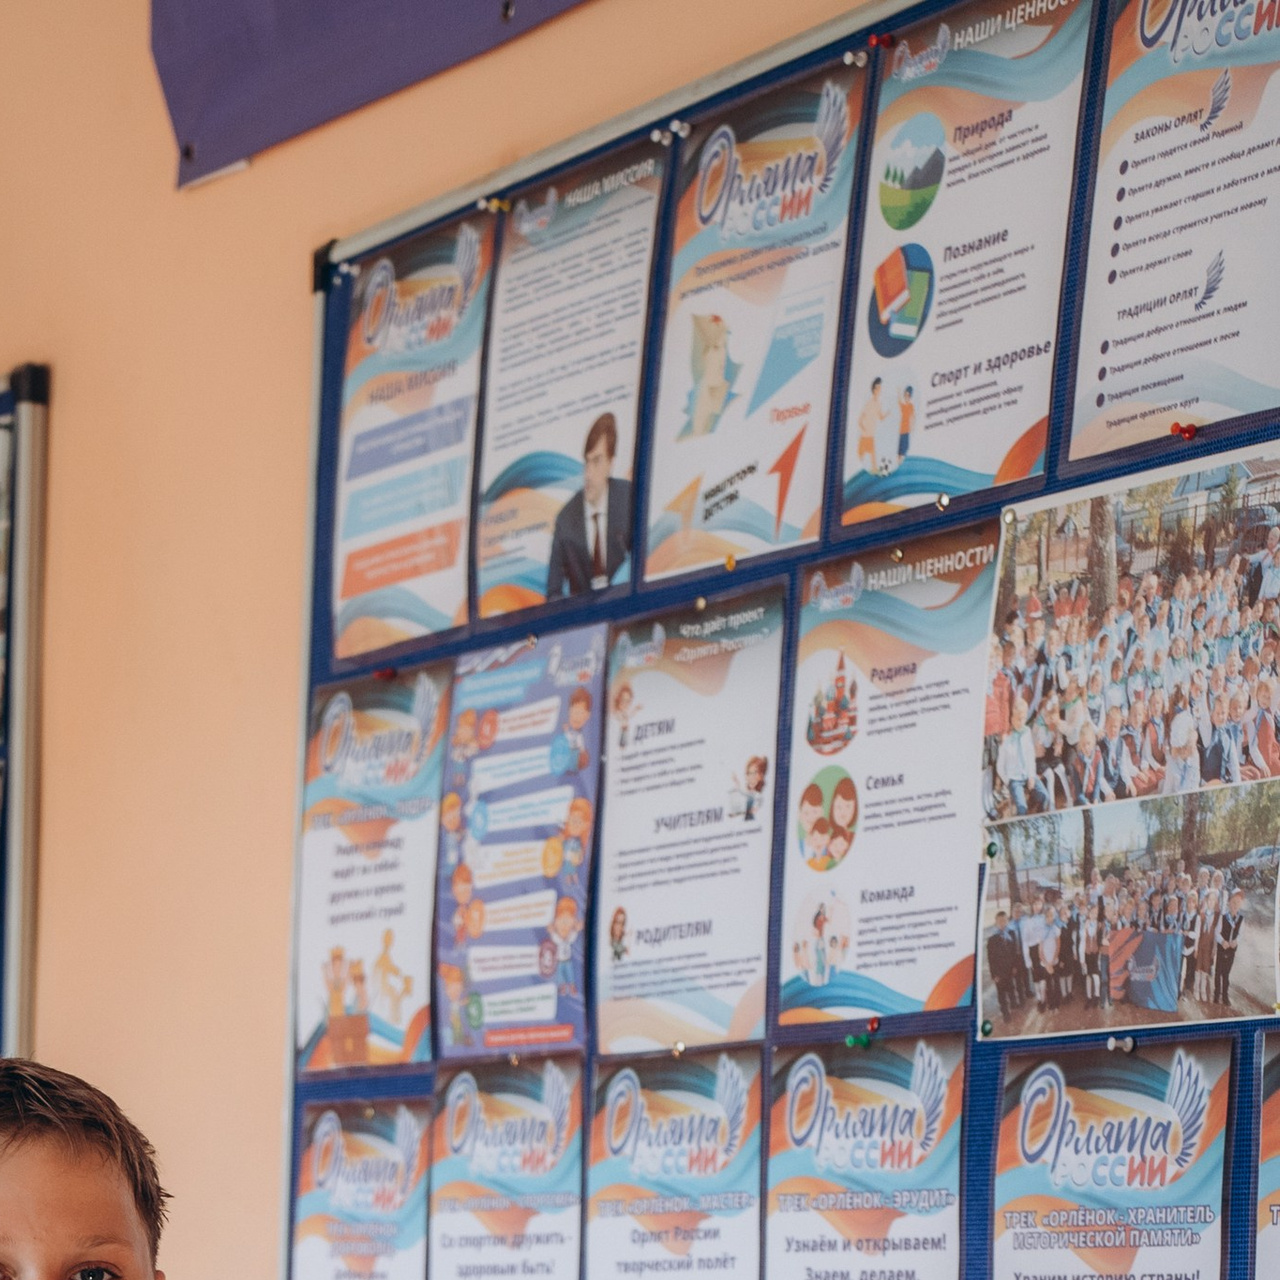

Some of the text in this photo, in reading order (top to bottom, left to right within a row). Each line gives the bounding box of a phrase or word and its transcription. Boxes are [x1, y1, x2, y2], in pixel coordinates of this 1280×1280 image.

[953, 14, 1002, 51] НАШИ
[953, 109, 1013, 144] Природа
[1134, 108, 1204, 143] ЗАКОНЫ ОРЛЯТ
[1131, 154, 1155, 169] Орлята
[697, 129, 818, 231] Орлята
[1128, 182, 1152, 196] Орлята
[1125, 210, 1149, 224] Орлята
[943, 229, 1009, 263] Познание
[1122, 237, 1146, 252] Орлята
[1119, 265, 1143, 279] Орлята
[1117, 286, 1198, 320] ТРАДИЦИИ ОРЛЯТ
[931, 340, 1052, 388] Спорт и здоровье
[868, 565, 913, 591] НАШИ
[915, 543, 995, 583] ЦЕННОСТИ
[679, 623, 701, 638] Что
[729, 607, 765, 629] проект
[870, 662, 917, 683] Родина
[634, 717, 676, 746] ДЕТЯМ
[865, 773, 904, 791] Семья
[654, 806, 724, 834] УЧИТЕЛЯМ
[860, 884, 915, 905] Команда
[634, 919, 713, 947] РОДИТЕЛЯМ
[607, 1070, 720, 1168] Орлята
[789, 1057, 918, 1158] Орлята
[1020, 1066, 1173, 1174] Орлята
[814, 1140, 913, 1172] РОССИИ
[1053, 1154, 1168, 1188] РОССИИ
[776, 1193, 810, 1213] ТРЕК
[892, 1187, 956, 1213] ЭРУДИТ»
[1003, 1211, 1037, 1230] ТРЕК
[1041, 1205, 1117, 1228] «ОРЛЁНОК
[1127, 1204, 1215, 1226] ХРАНИТЕЛЬ
[458, 1234, 508, 1253] спортом
[511, 1231, 565, 1251] дружить
[673, 1225, 720, 1244] России
[785, 1233, 948, 1257] Узнаём и открываем!
[1012, 1226, 1202, 1250] ИСТОРИЧЕСКОЙ ПАМЯТИ»
[616, 1252, 737, 1278] творческий полёт
